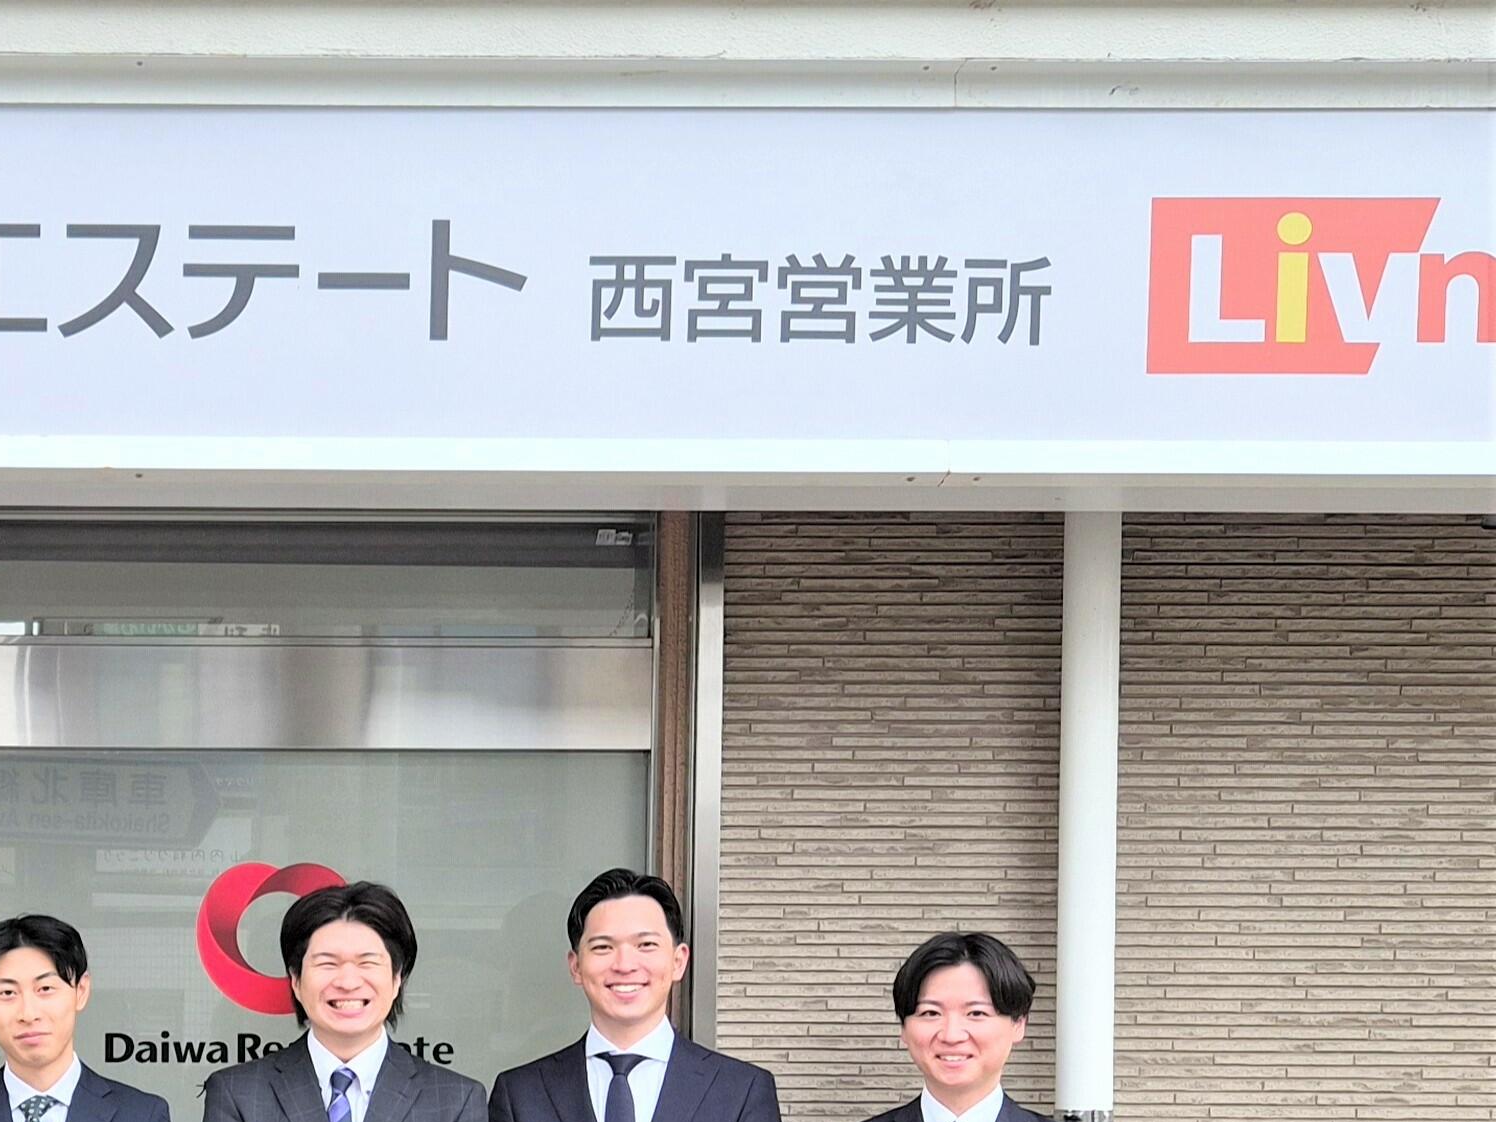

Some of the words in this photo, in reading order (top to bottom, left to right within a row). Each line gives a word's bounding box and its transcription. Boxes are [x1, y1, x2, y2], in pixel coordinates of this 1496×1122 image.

[588, 252, 1052, 346] 西宮営業所
[104, 1030, 229, 1064] Daiwa
